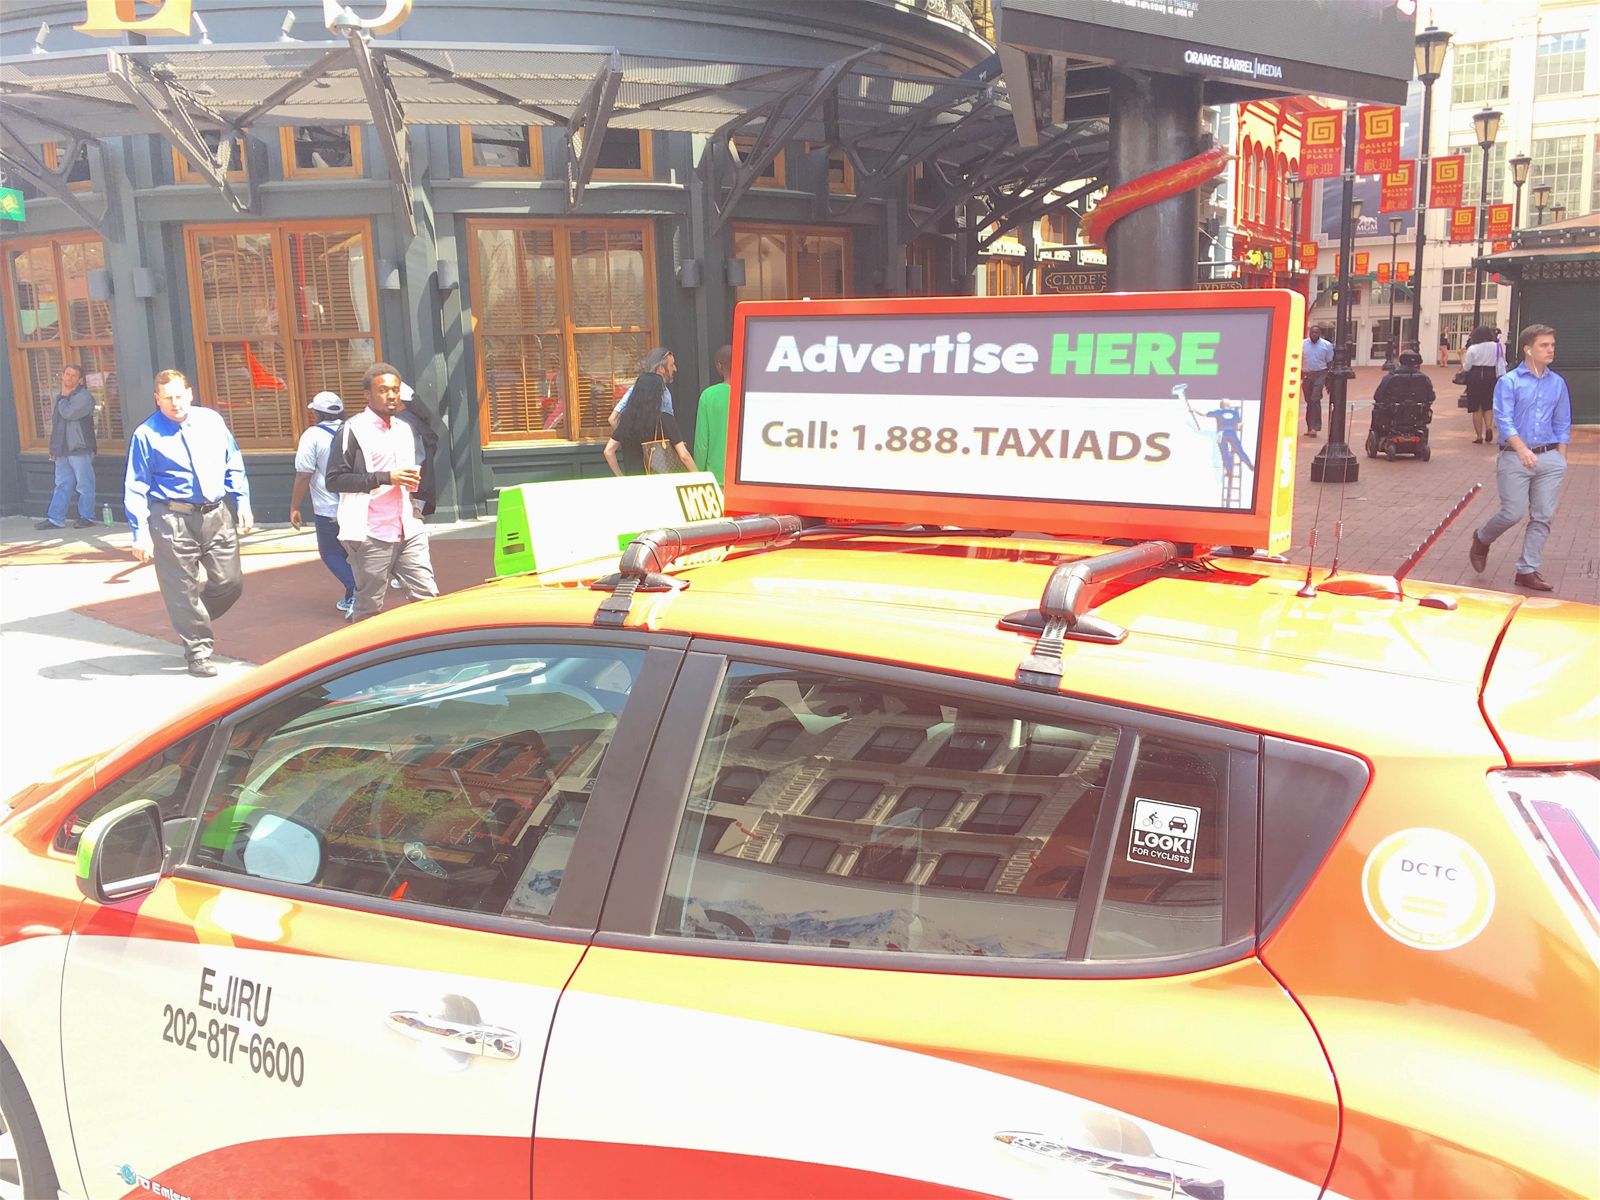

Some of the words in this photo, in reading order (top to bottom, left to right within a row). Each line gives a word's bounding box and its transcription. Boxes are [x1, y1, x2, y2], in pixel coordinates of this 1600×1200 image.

[1184, 50, 1222, 68] ORANGE
[1223, 57, 1254, 74] BARREL
[1257, 63, 1282, 78] MEDIA
[1300, 147, 1341, 155] GALLERY
[1360, 141, 1400, 149] GALLERY
[1356, 224, 1378, 232] MGM
[1052, 273, 1107, 286] CLYDE'S
[765, 331, 1039, 375] Advertise
[1050, 331, 1221, 376] HERE
[761, 421, 838, 450] Call:
[852, 424, 1171, 463] 1.888.TAXIADS
[680, 485, 721, 521] M108
[1133, 830, 1192, 855] LOOK!
[1132, 847, 1149, 857] FOR
[1150, 850, 1190, 864] CYCLISTS
[1401, 859, 1458, 881] DCTC
[198, 967, 273, 1027] E.JIRU
[162, 1004, 305, 1088] 202-817-6600
